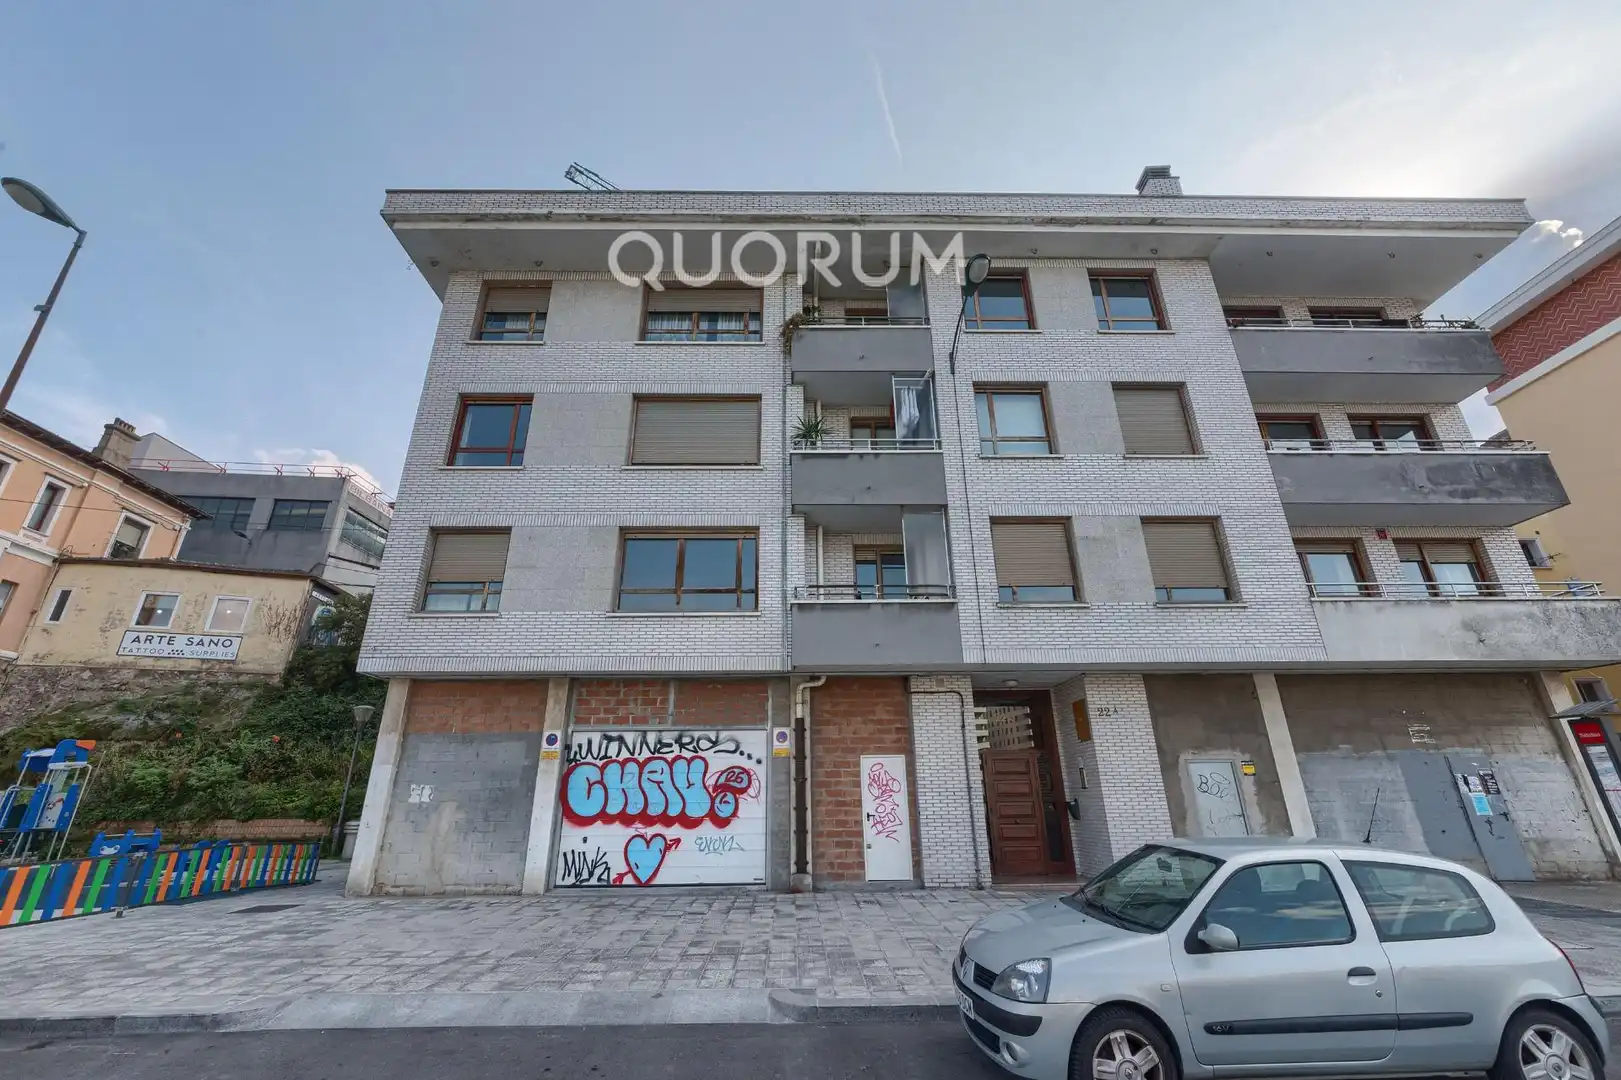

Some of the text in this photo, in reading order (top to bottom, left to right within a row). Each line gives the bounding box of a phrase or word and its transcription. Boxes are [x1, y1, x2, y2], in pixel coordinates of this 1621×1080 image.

[131, 634, 233, 648] ARTE SANO
[121, 646, 235, 658] TATTOO SUPPLIES
[1097, 706, 1111, 717] 22
